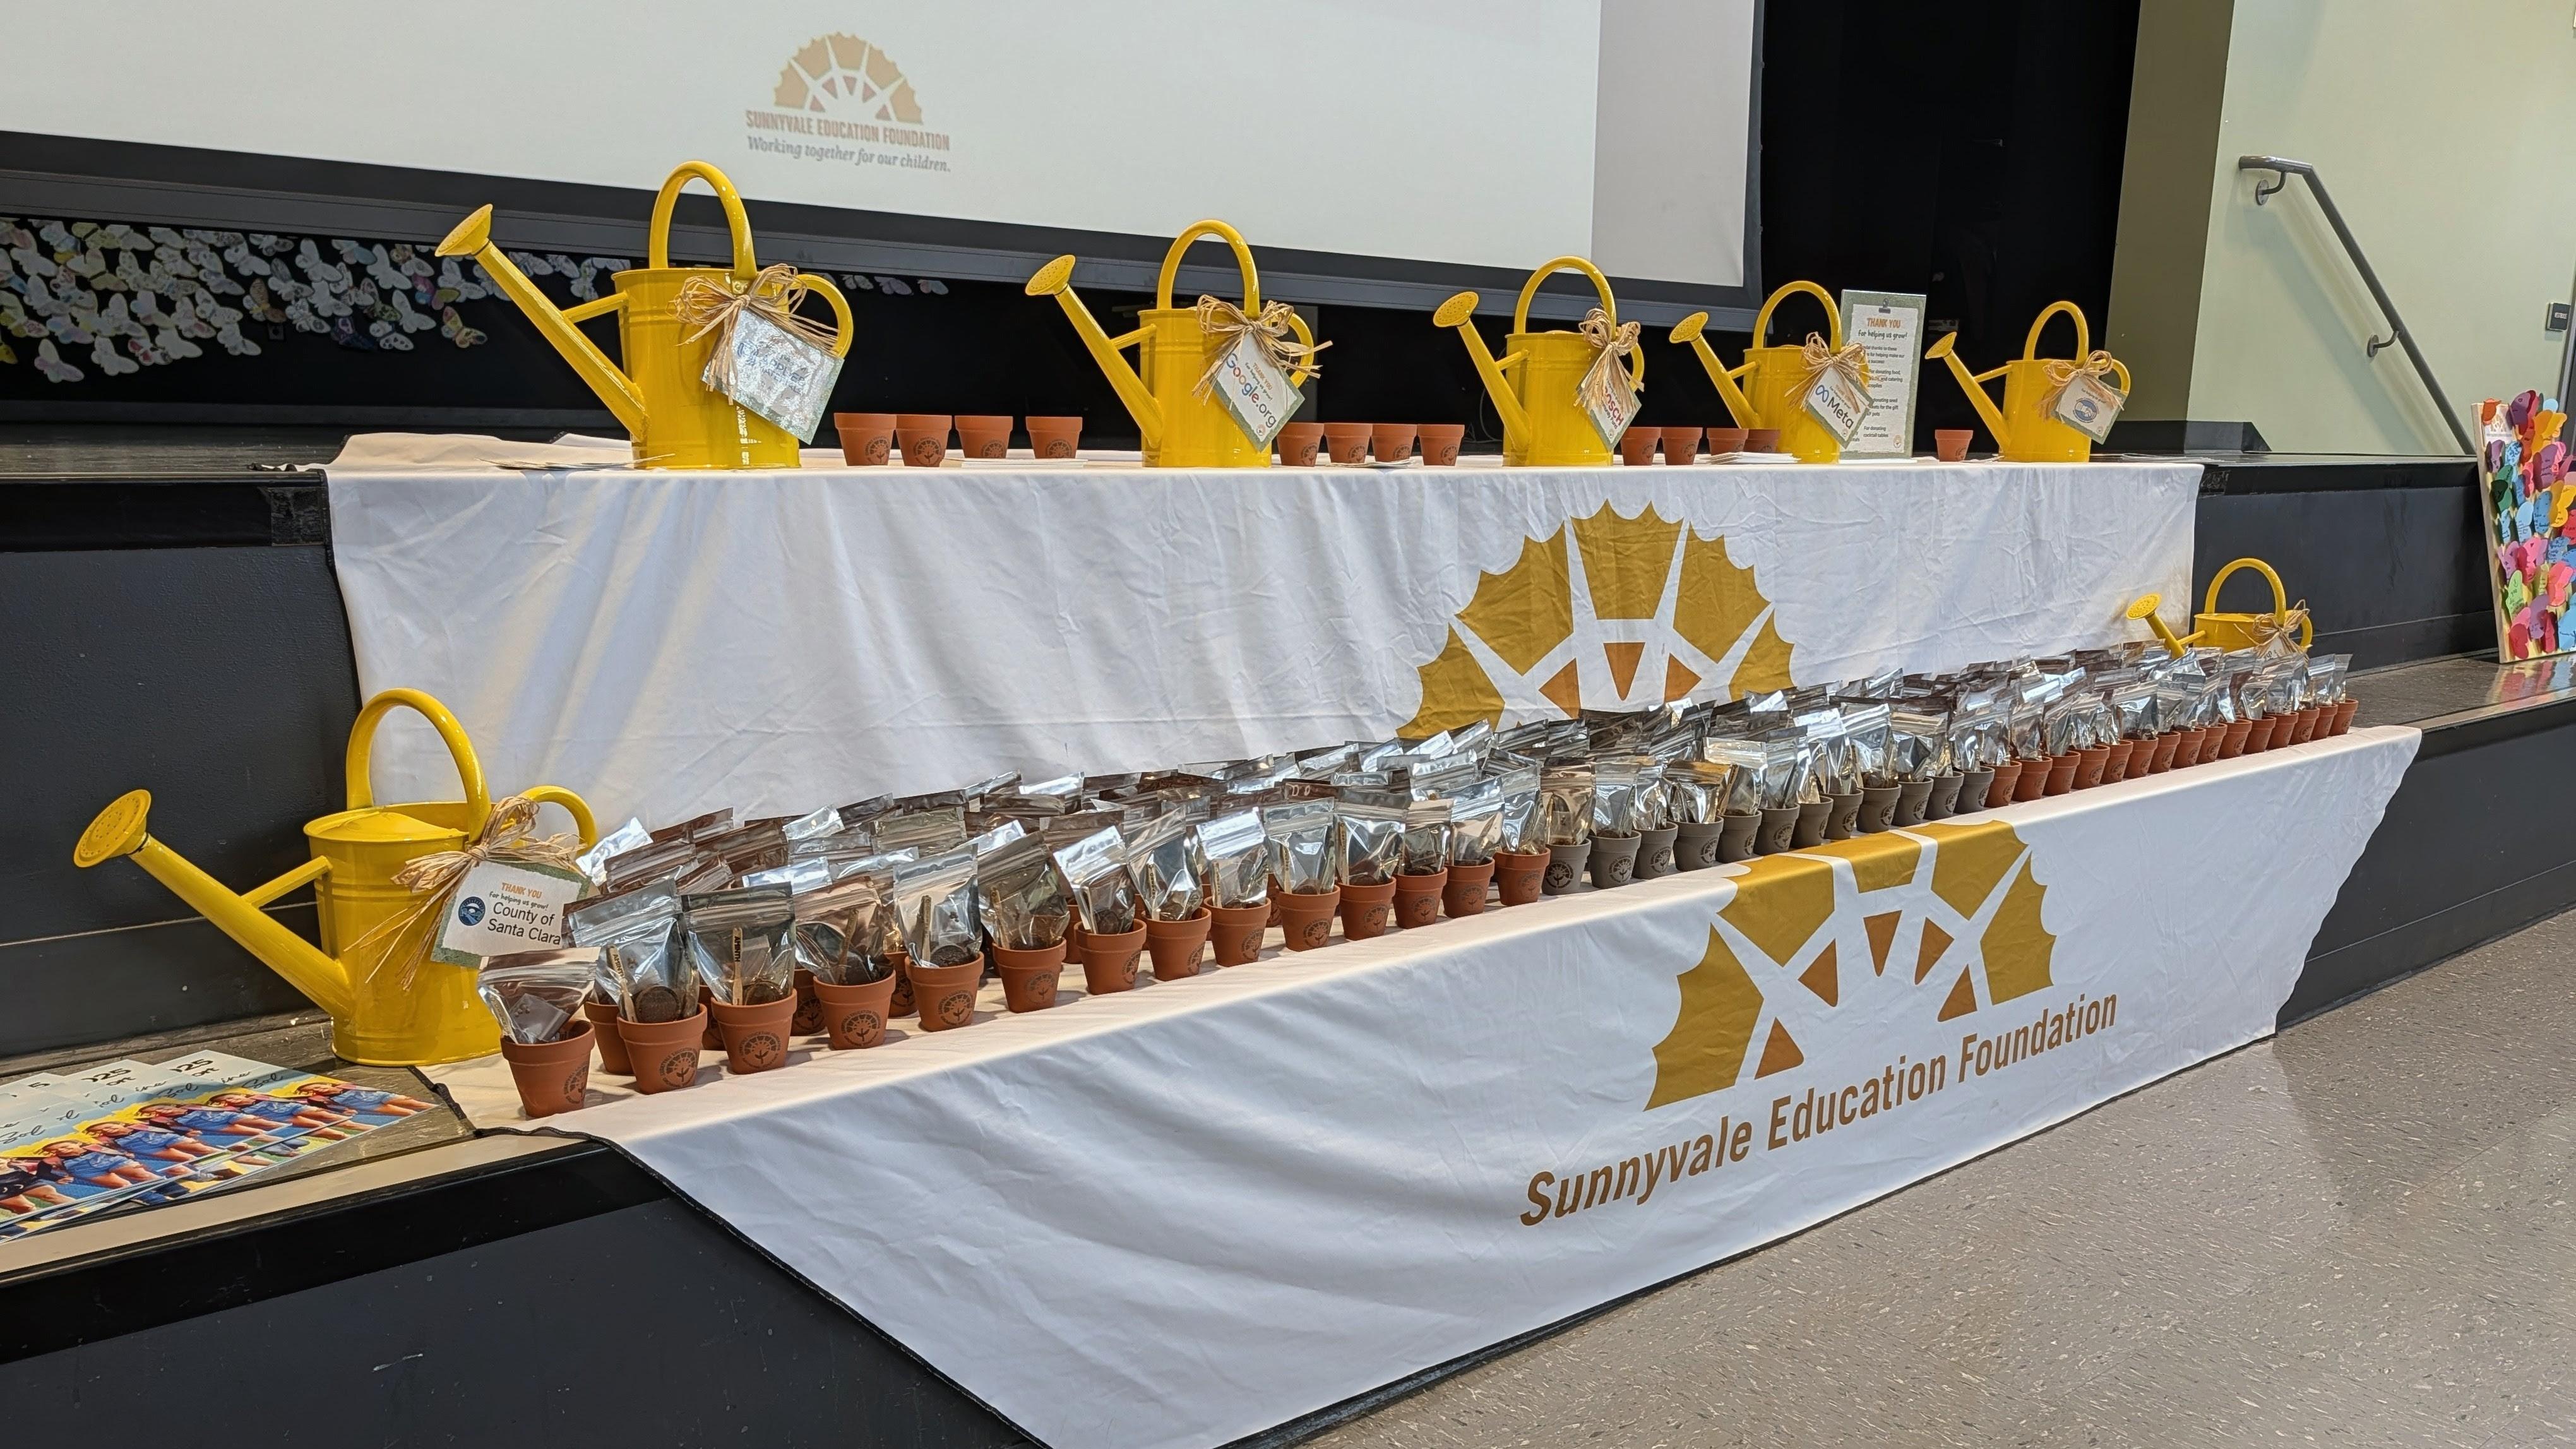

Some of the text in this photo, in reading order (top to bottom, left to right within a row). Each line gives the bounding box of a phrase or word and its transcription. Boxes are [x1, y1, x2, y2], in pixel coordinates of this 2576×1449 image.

[746, 109, 950, 151] SUNNYVALE EDUCATION FOUNDATION
[747, 136, 951, 172] Working together for our children.
[1867, 318, 1900, 328] THANK YOU
[1868, 330, 1885, 340] helping
[1893, 332, 1908, 340] grow!
[1253, 362, 1273, 391] THANK YOU
[1227, 354, 1277, 428] Google.org
[1605, 386, 1624, 426] OSCH
[1827, 397, 1854, 429] Meta
[500, 892, 522, 905] helping
[530, 901, 549, 911] grow!
[501, 883, 542, 899] THANK YOU
[493, 902, 539, 925] County
[540, 914, 556, 926] of
[487, 918, 561, 946] Santa Clara
[81, 1068, 132, 1083] 25
[170, 1059, 213, 1072] 25
[1520, 993, 2118, 1227] Sunnyvale Education Foundation
